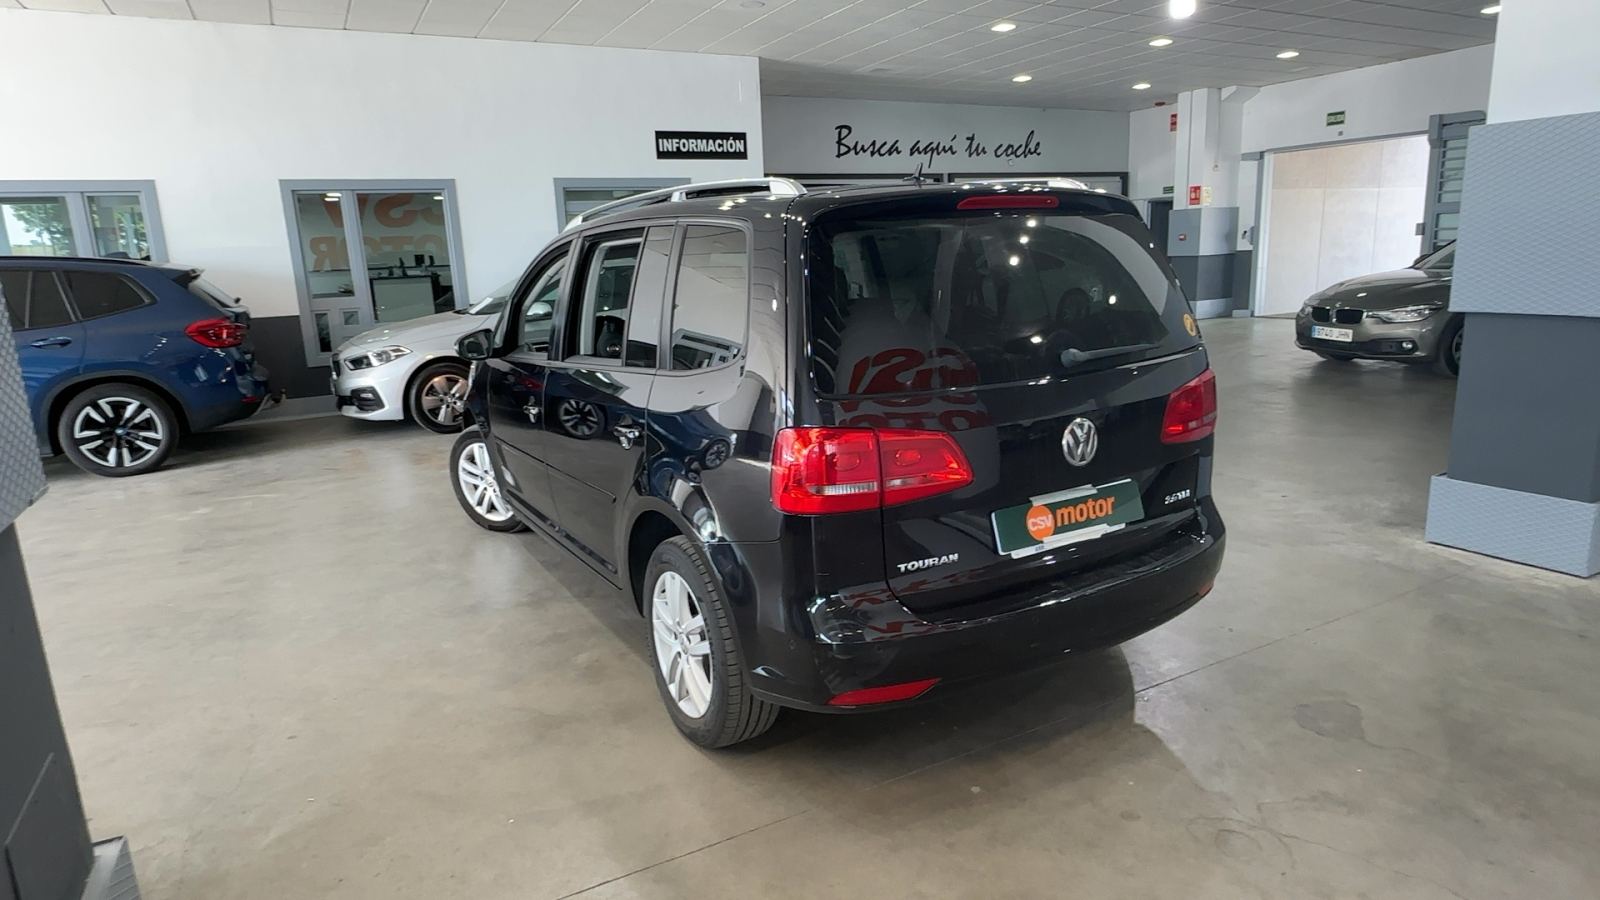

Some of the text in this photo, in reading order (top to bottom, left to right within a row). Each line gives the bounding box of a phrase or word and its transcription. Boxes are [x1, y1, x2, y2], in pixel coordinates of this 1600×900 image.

[658, 136, 745, 152] INFORMACIÓN
[834, 124, 1041, 168] Busca aquí tu coche
[1027, 496, 1116, 532] CSV motor
[897, 553, 959, 572] TOURAN
